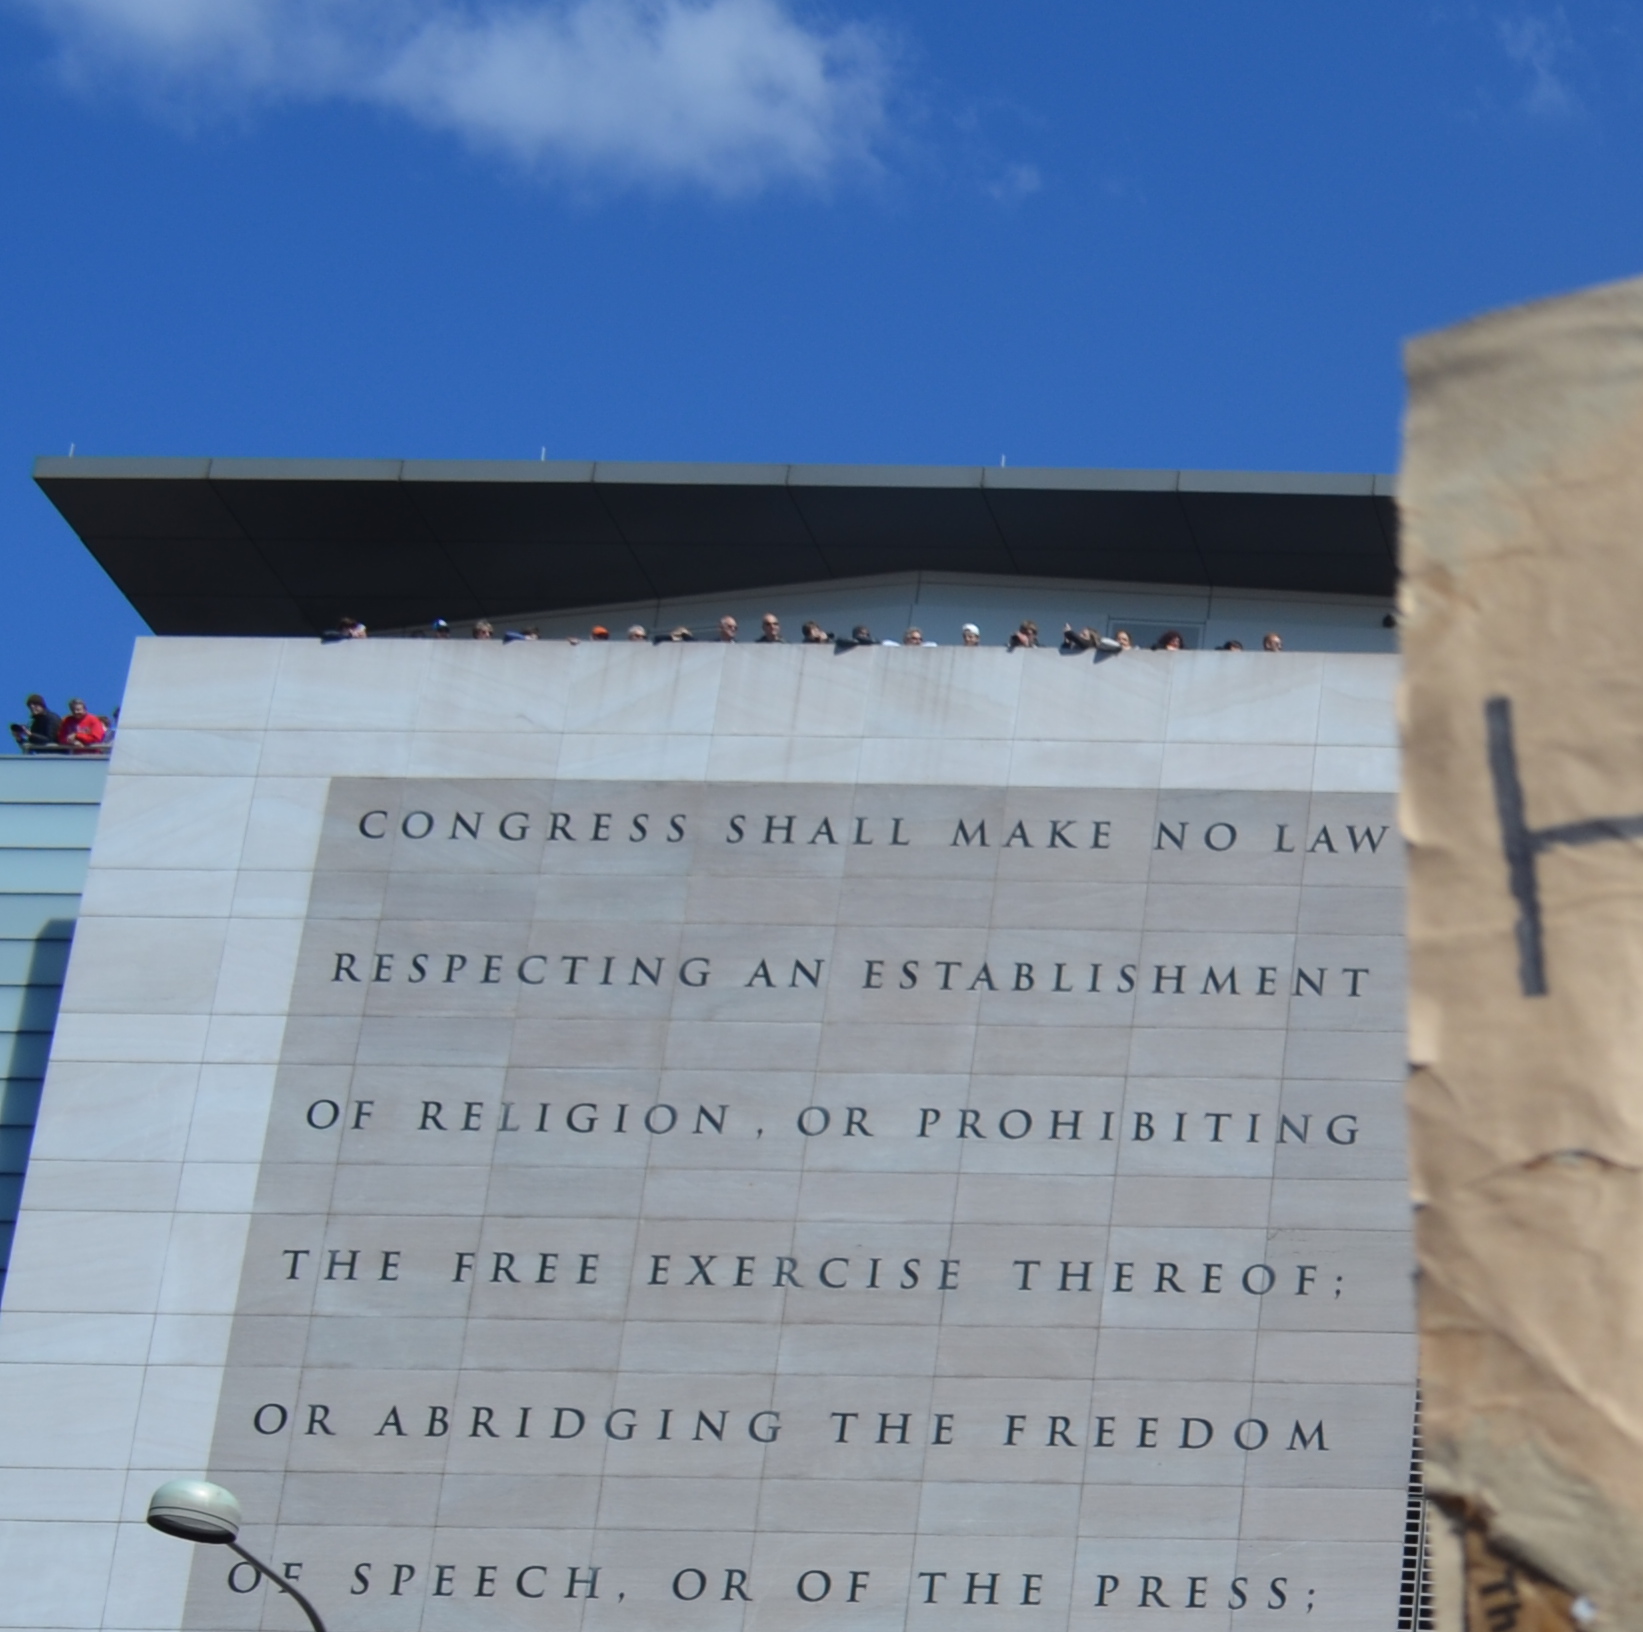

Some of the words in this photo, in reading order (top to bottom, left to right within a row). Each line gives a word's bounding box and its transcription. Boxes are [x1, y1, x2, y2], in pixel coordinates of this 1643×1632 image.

[357, 808, 687, 844] CONGRESS
[725, 813, 910, 847] SHALL
[949, 817, 1112, 850] MAKE
[1153, 821, 1238, 853] NO
[1273, 823, 1391, 855] LAW
[330, 951, 711, 988] RESPECTING
[743, 957, 826, 989] AN
[861, 958, 1371, 998] ESTABLISHMENT
[305, 1098, 376, 1131] OF
[795, 1105, 875, 1138] OR
[916, 1106, 1360, 1147] PROHIBITING
[281, 1248, 402, 1283] THE
[450, 1250, 600, 1286] FREE
[646, 1253, 962, 1292] EXERCISE
[1012, 1259, 1344, 1299] THEREOF;
[252, 1402, 337, 1437] OR
[373, 1404, 783, 1445] ABRIDGING
[829, 1410, 956, 1446] THE
[1002, 1413, 1330, 1452] FREEDOM
[226, 1560, 304, 1595] OF
[349, 1561, 626, 1604] SPEECH,
[671, 1567, 754, 1603] OR
[795, 1568, 871, 1604] OF
[916, 1570, 1044, 1607] THE
[1093, 1573, 1316, 1614] PRESS;
